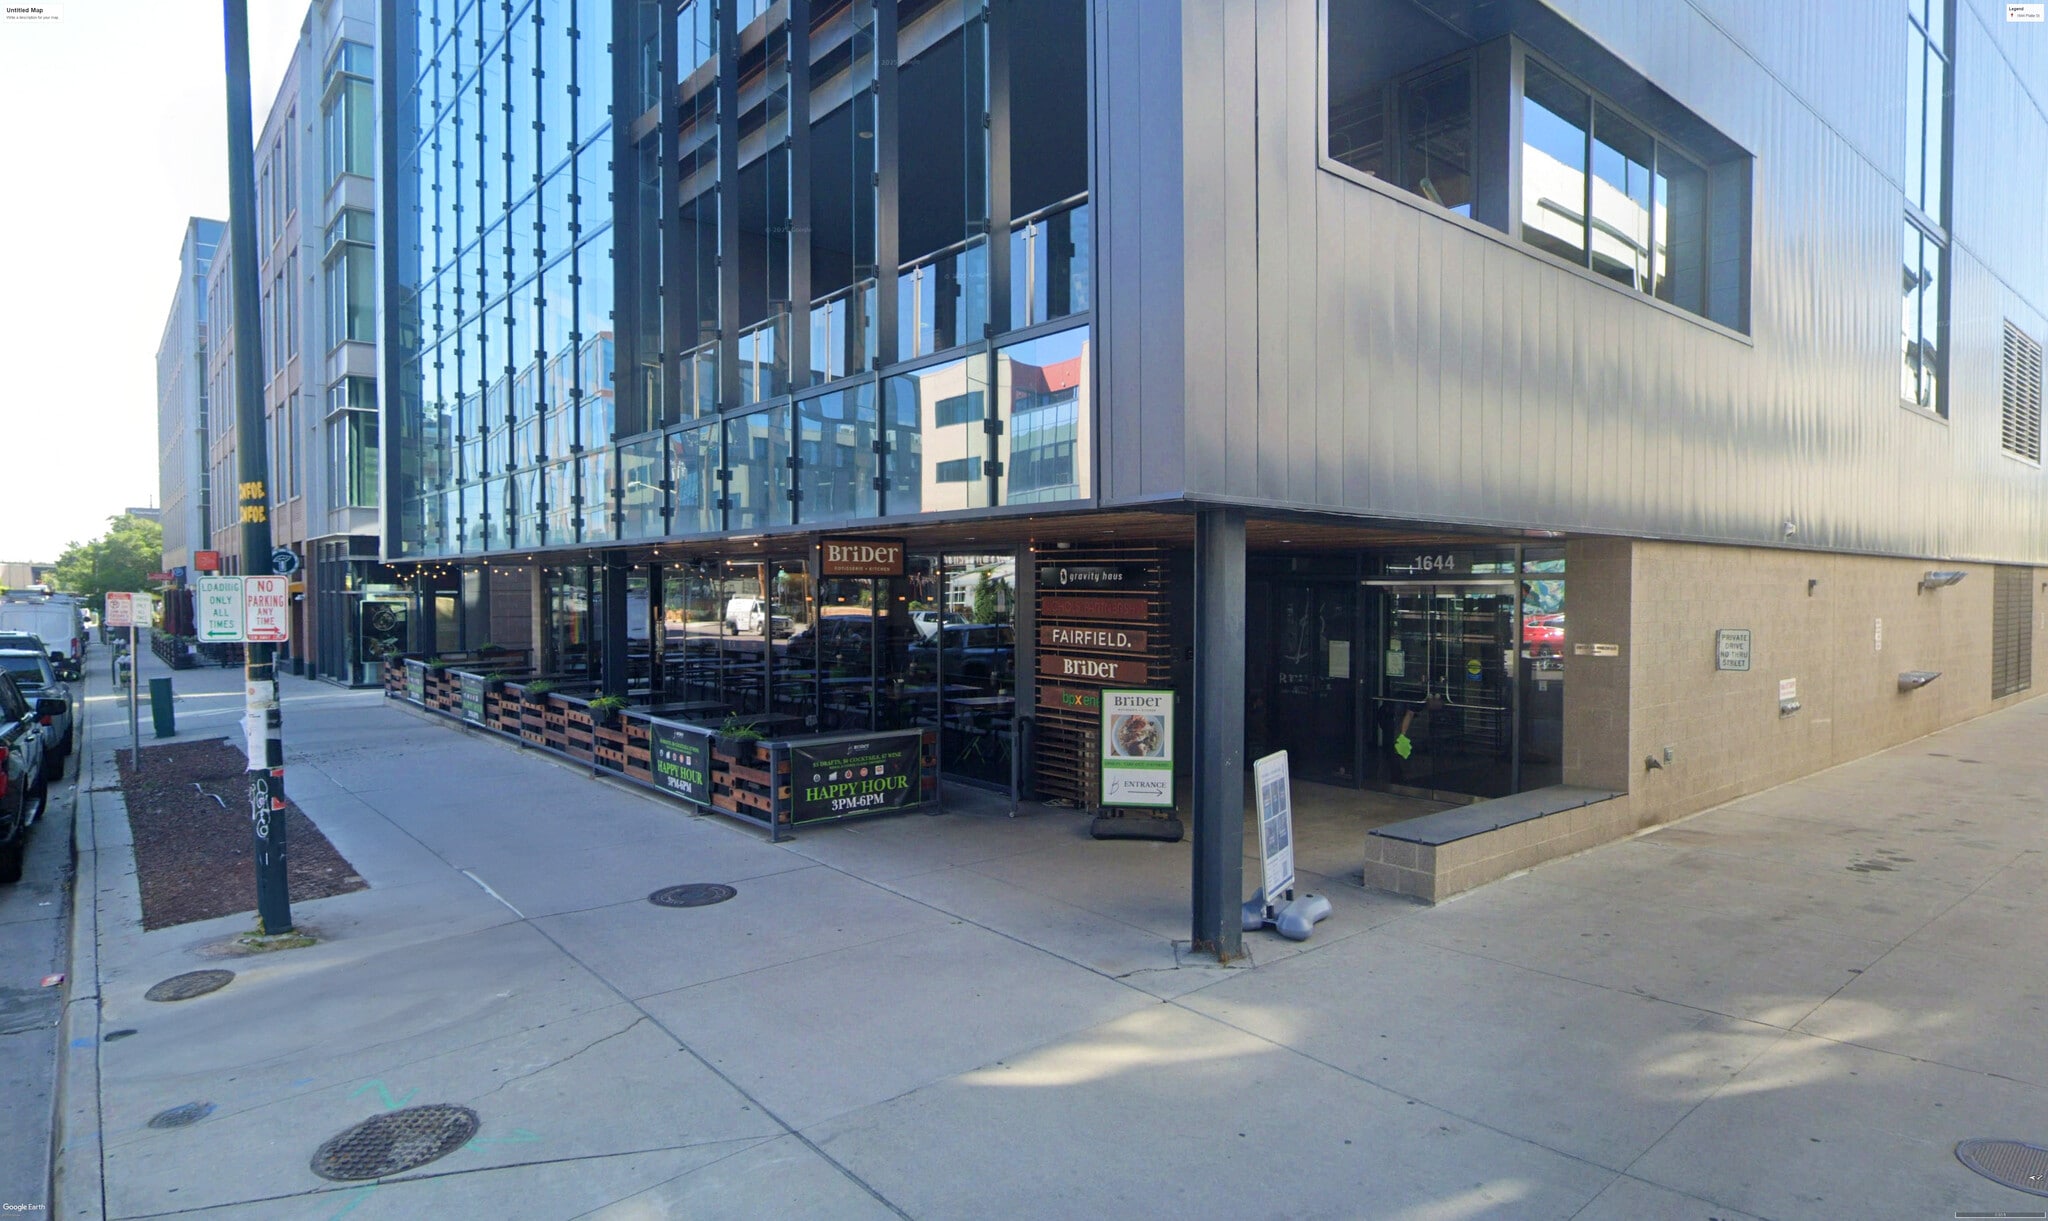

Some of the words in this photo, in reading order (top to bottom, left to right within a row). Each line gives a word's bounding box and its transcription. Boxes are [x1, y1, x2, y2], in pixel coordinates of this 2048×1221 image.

[1415, 555, 1454, 570] 1644
[1070, 572, 1099, 582] gravity
[1102, 571, 1123, 580] haus
[202, 583, 239, 592] LOADING
[257, 581, 273, 592] NO
[210, 596, 232, 604] ONLY
[248, 595, 284, 607] PARKING
[209, 620, 233, 628] TIMES
[257, 617, 275, 625] TIME
[1052, 629, 1132, 648] FAIRFIELD.
[657, 760, 679, 777] HAPPY
[680, 767, 703, 785] HOUR
[806, 782, 858, 802] HAPPY
[860, 775, 909, 793] HOUR
[832, 792, 885, 811] 3PM-6PM
